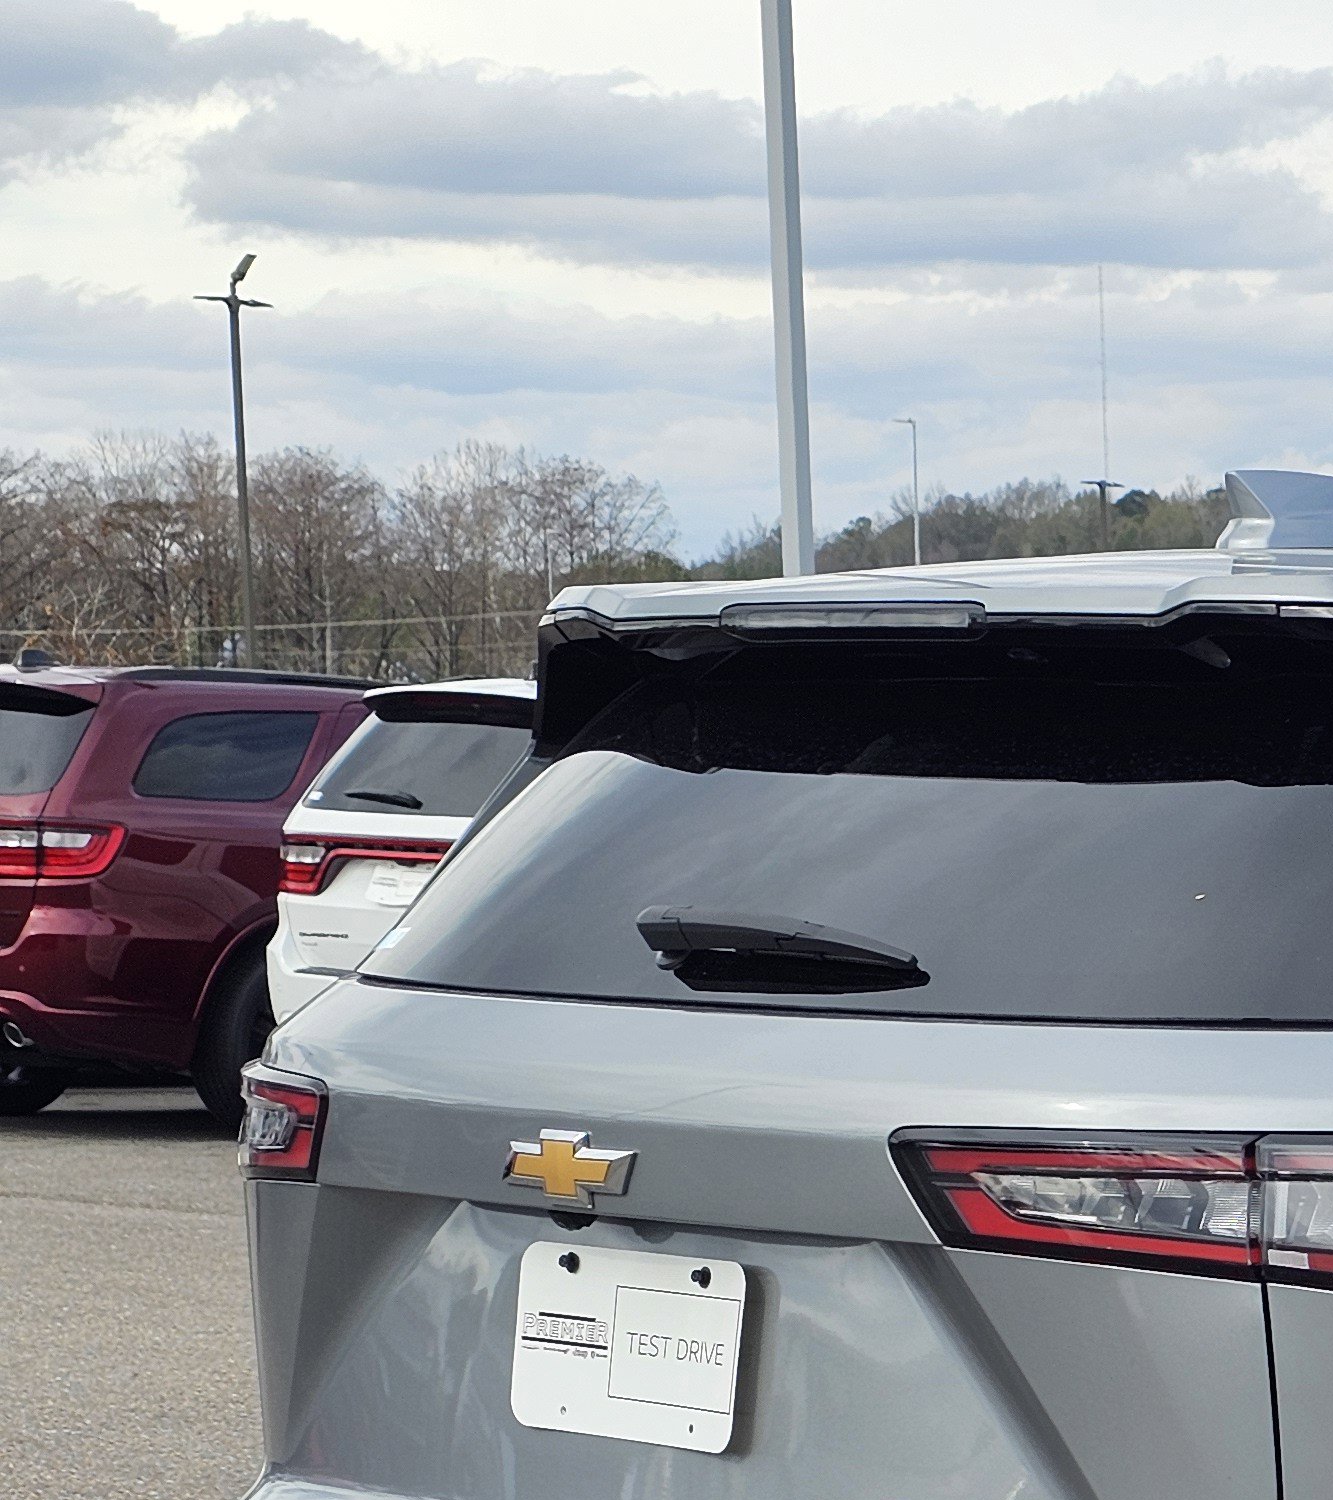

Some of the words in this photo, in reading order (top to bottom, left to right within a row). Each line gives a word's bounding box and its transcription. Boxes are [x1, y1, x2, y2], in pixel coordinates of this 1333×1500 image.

[522, 1312, 609, 1344] PREMIER
[626, 1331, 672, 1359] TEST
[676, 1338, 725, 1366] DRIVE
